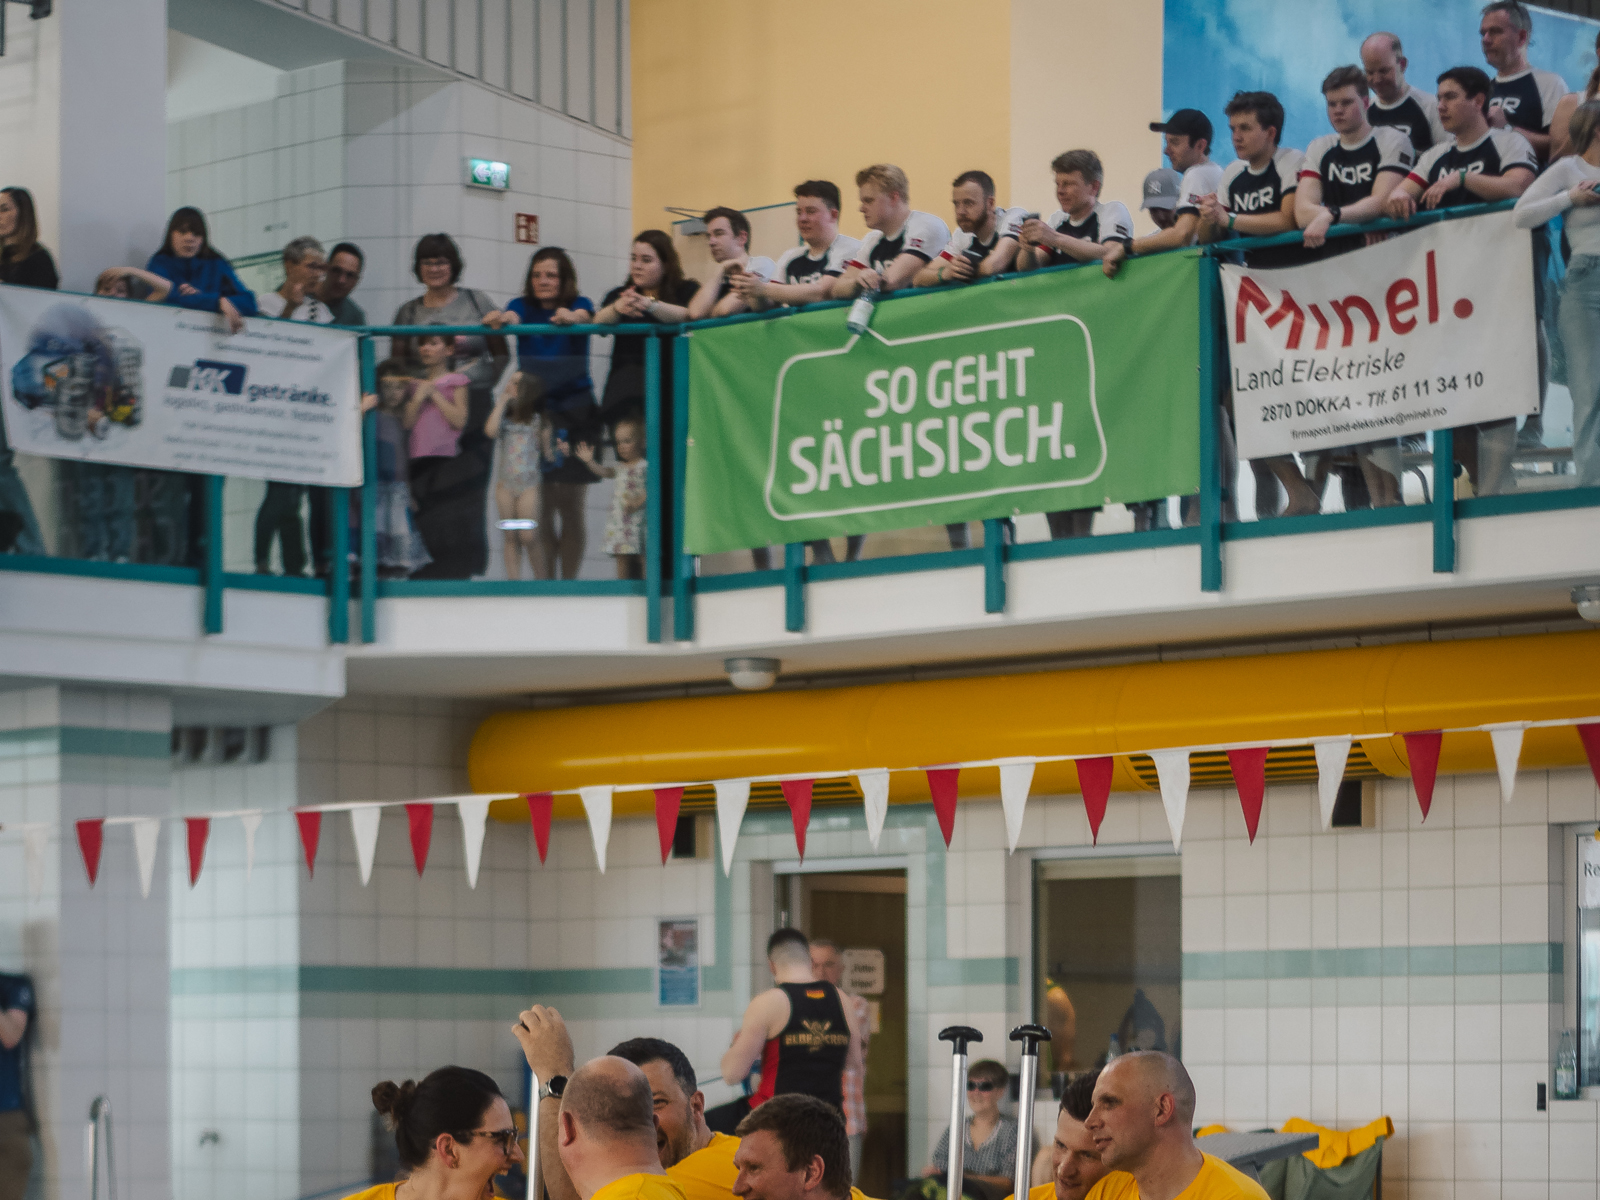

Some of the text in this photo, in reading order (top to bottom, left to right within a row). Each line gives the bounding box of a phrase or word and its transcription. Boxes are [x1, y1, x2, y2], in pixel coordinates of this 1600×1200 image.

[1328, 162, 1372, 185] NOR
[865, 347, 1035, 418] SO GEHT
[1236, 347, 1406, 392] Land Elektriske
[1261, 402, 1293, 423] 2870
[1296, 395, 1351, 417] DOKKA
[1392, 384, 1407, 402] 61
[1413, 379, 1430, 398] 11
[1437, 374, 1459, 394] 34
[1464, 370, 1485, 390] 10
[788, 401, 1077, 495] SÄCHSISCH.
